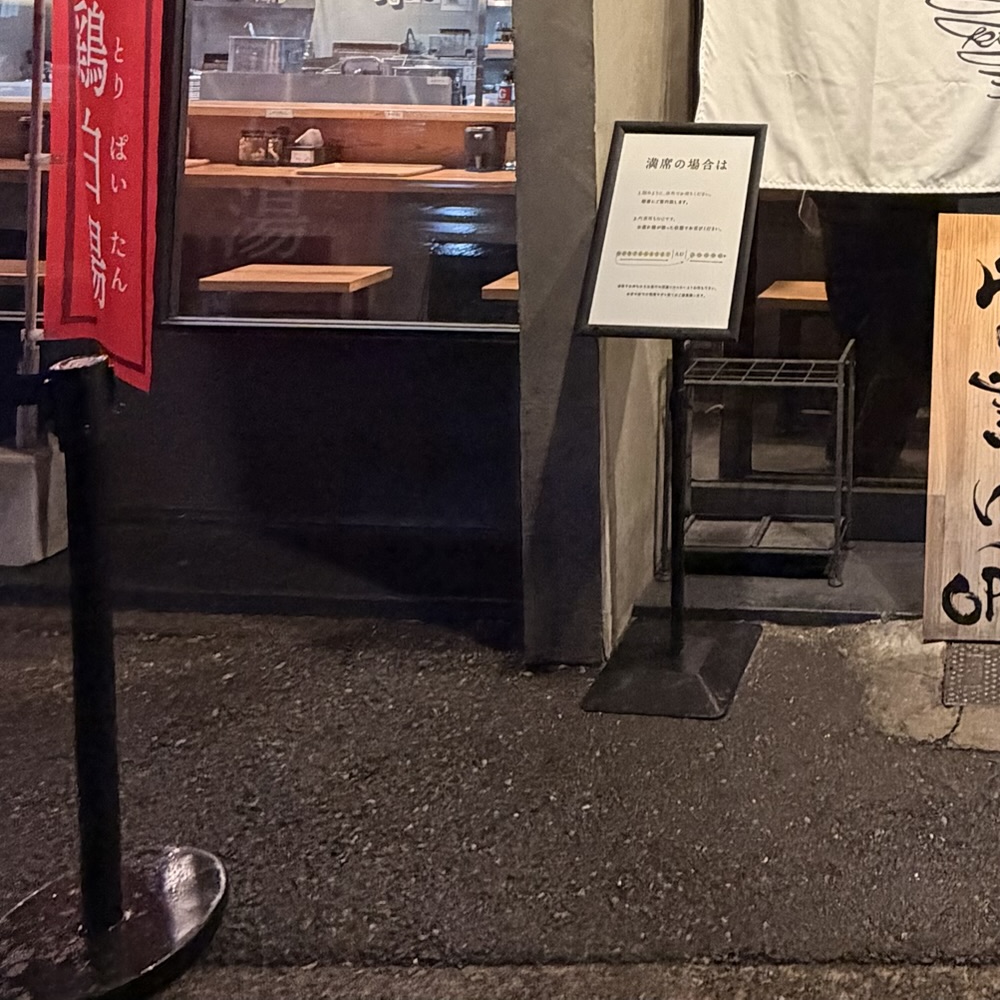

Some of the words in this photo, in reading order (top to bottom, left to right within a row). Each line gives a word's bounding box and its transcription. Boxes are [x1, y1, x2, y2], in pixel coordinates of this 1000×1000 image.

[645, 156, 728, 171] 満席の場合は
